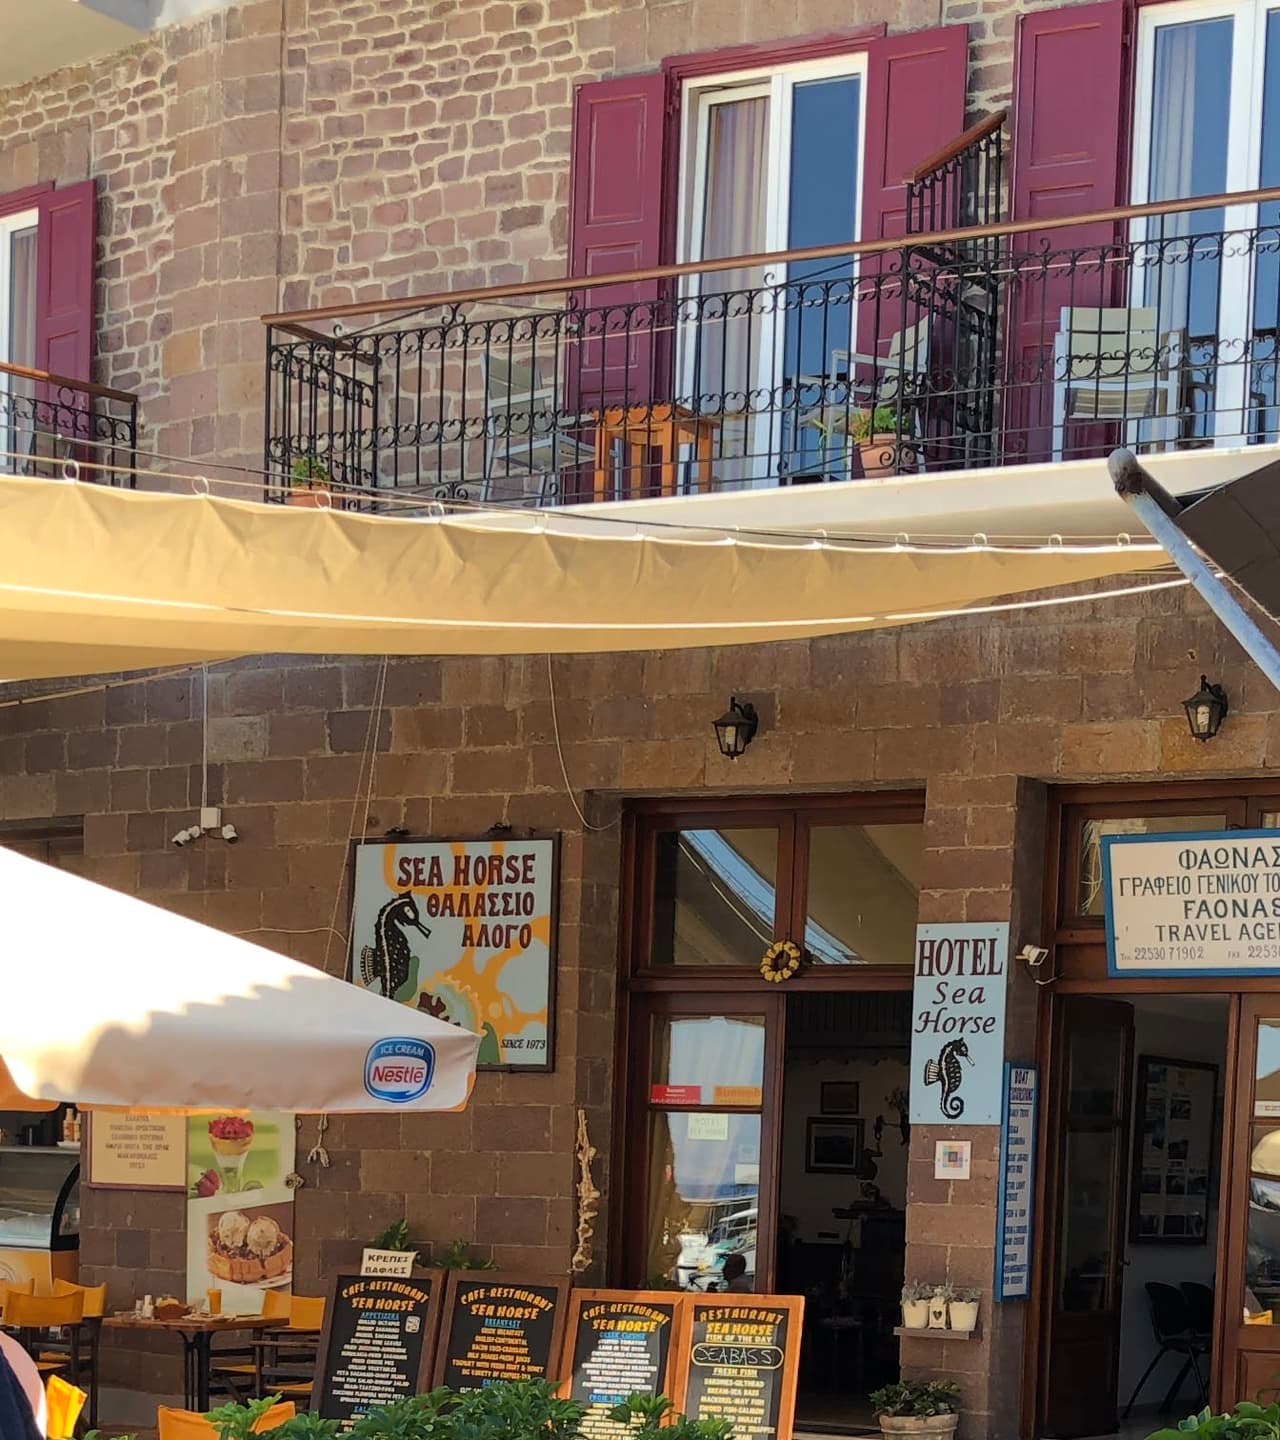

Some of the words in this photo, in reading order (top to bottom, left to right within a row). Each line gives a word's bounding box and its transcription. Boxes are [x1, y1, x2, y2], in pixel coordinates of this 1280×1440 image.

[397, 855, 444, 887] SEA
[453, 853, 536, 886] HORSE
[1119, 875, 1191, 897] ΓΡΑΦΕΙΟ
[1197, 873, 1260, 895] ΓΕΝΙΚΟΥ
[426, 891, 535, 918] ΘΑΛΑΣΣΙΟ
[461, 923, 532, 949] ΑΛΟΓΟ
[1154, 924, 1233, 942] TRAVEL
[916, 938, 1003, 977] HOTEL
[1134, 946, 1166, 961] 22530
[1169, 946, 1204, 960] 71902
[932, 981, 986, 1005] Sea
[914, 1007, 996, 1033] Horse
[380, 1045, 393, 1055] ICE
[394, 1044, 425, 1057] CREAM
[500, 1038, 524, 1049] SINCE
[526, 1039, 546, 1050] 1973
[351, 1297, 374, 1309] SEA
[375, 1298, 416, 1312] HORSE
[471, 1303, 495, 1317] SEA
[497, 1305, 540, 1320] HORSE
[700, 1307, 784, 1325] RESTAURANT
[592, 1319, 614, 1330] SEA
[616, 1319, 658, 1333] HORSE
[707, 1322, 730, 1334] SEA
[732, 1323, 774, 1336] HORSE
